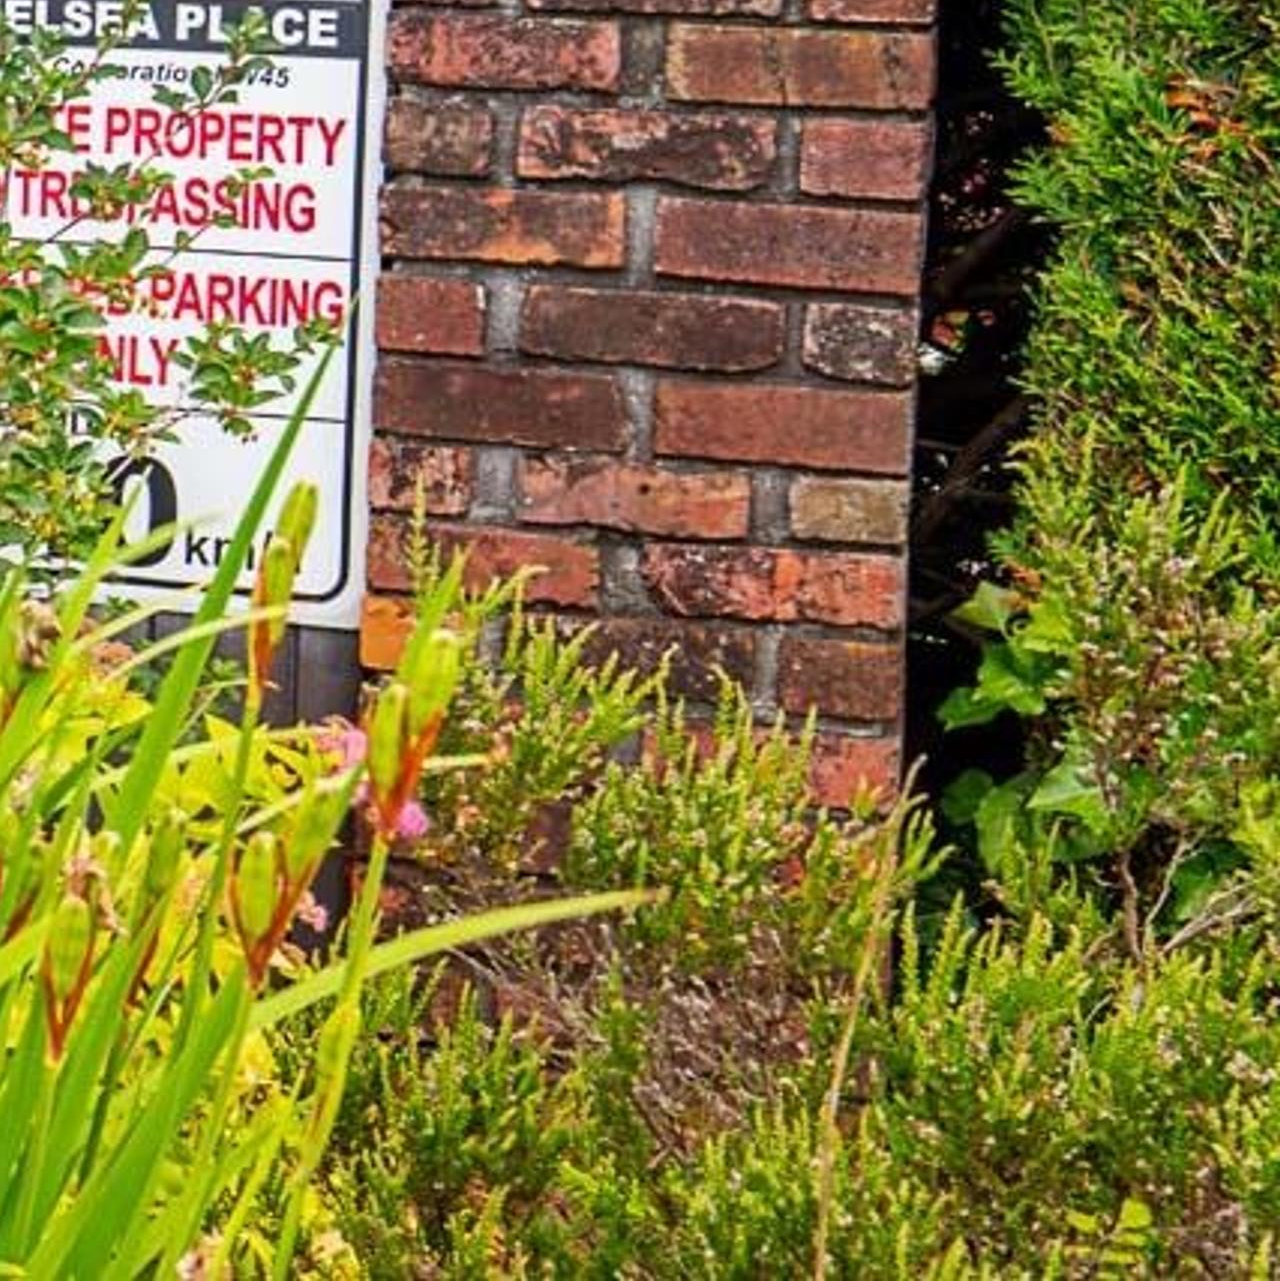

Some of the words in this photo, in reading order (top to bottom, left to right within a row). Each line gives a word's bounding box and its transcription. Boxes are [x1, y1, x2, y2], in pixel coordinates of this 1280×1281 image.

[175, 3, 339, 48] PLCE
[53, 56, 198, 85] Cooratio
[104, 107, 346, 166] PROPERTY
[14, 170, 317, 234] TRASSING
[149, 271, 344, 328] PARKING
[93, 334, 181, 387] NLY
